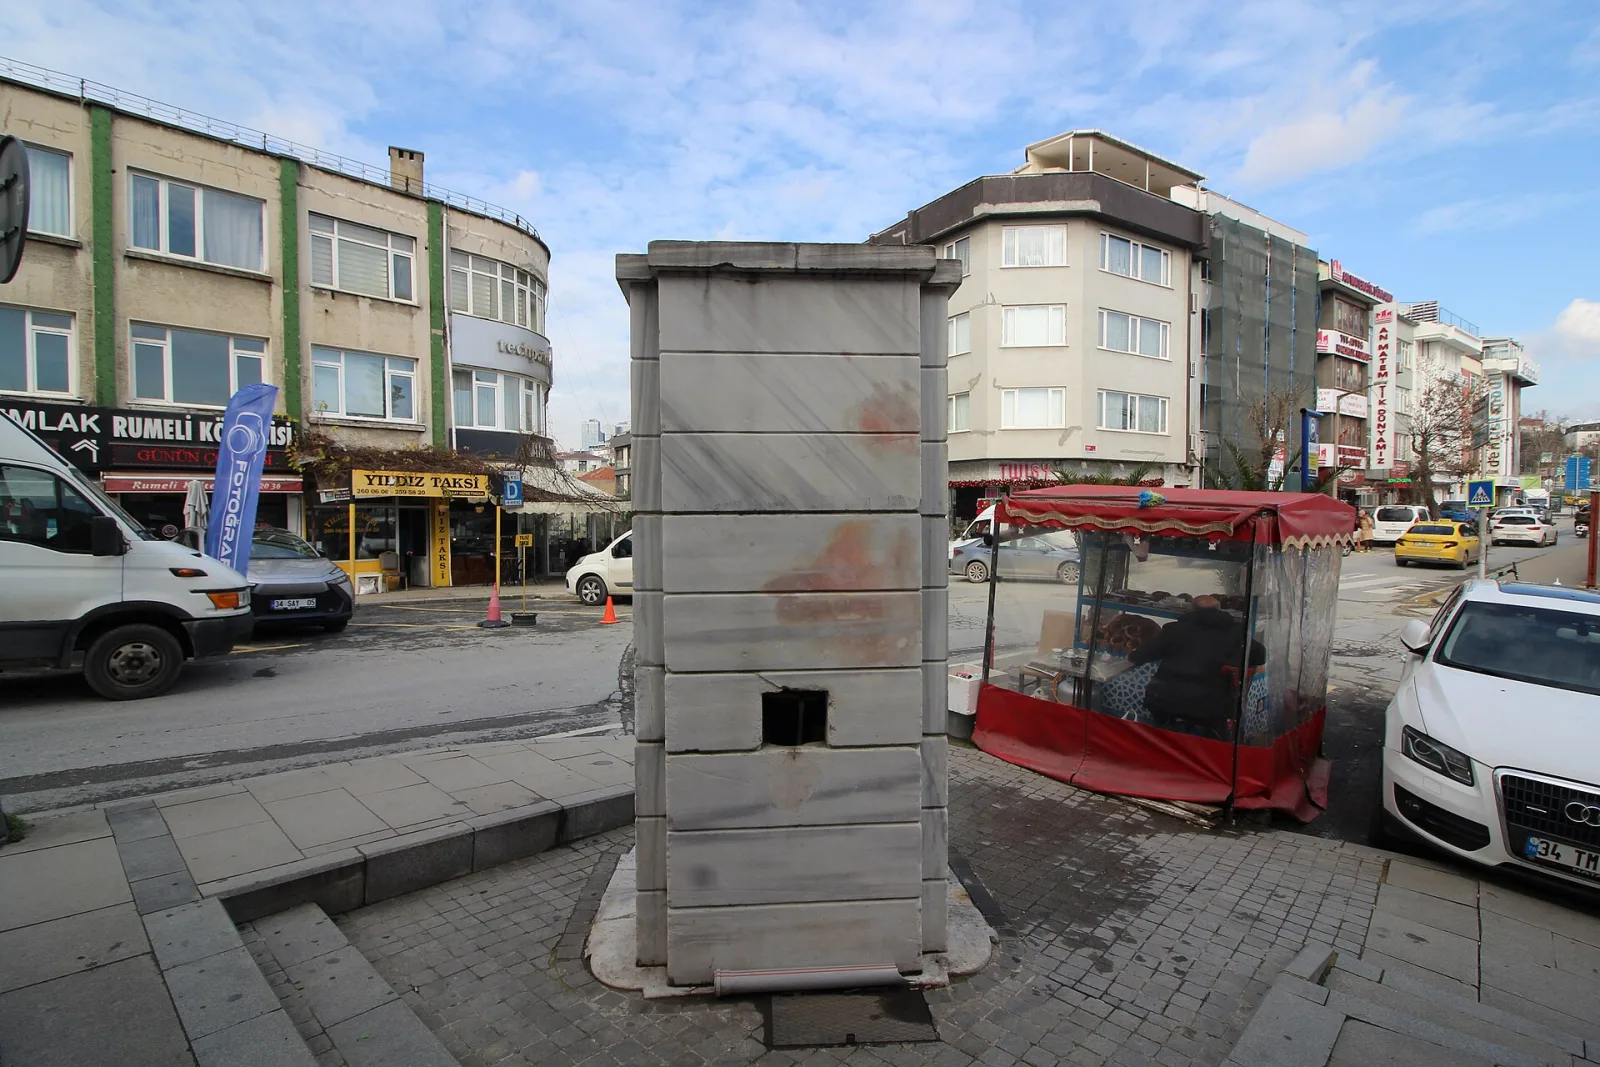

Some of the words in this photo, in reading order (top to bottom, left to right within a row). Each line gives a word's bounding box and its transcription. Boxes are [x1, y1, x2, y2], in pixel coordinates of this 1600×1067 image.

[1379, 327, 1388, 341] AN
[1377, 343, 1389, 405] MATEMTİK
[0, 408, 101, 433] MLAK
[112, 414, 192, 441] RUMELİ
[200, 416, 292, 446] KÖİSİ
[137, 449, 200, 463] GÜNÜN
[132, 481, 178, 490] Rumeli
[364, 474, 424, 488] YILDIZ
[430, 476, 479, 489] TAKSİ
[506, 482, 518, 499] D
[438, 537, 447, 580] TAKSİ
[1538, 840, 1562, 860] 34
[1575, 849, 1600, 871] TM
